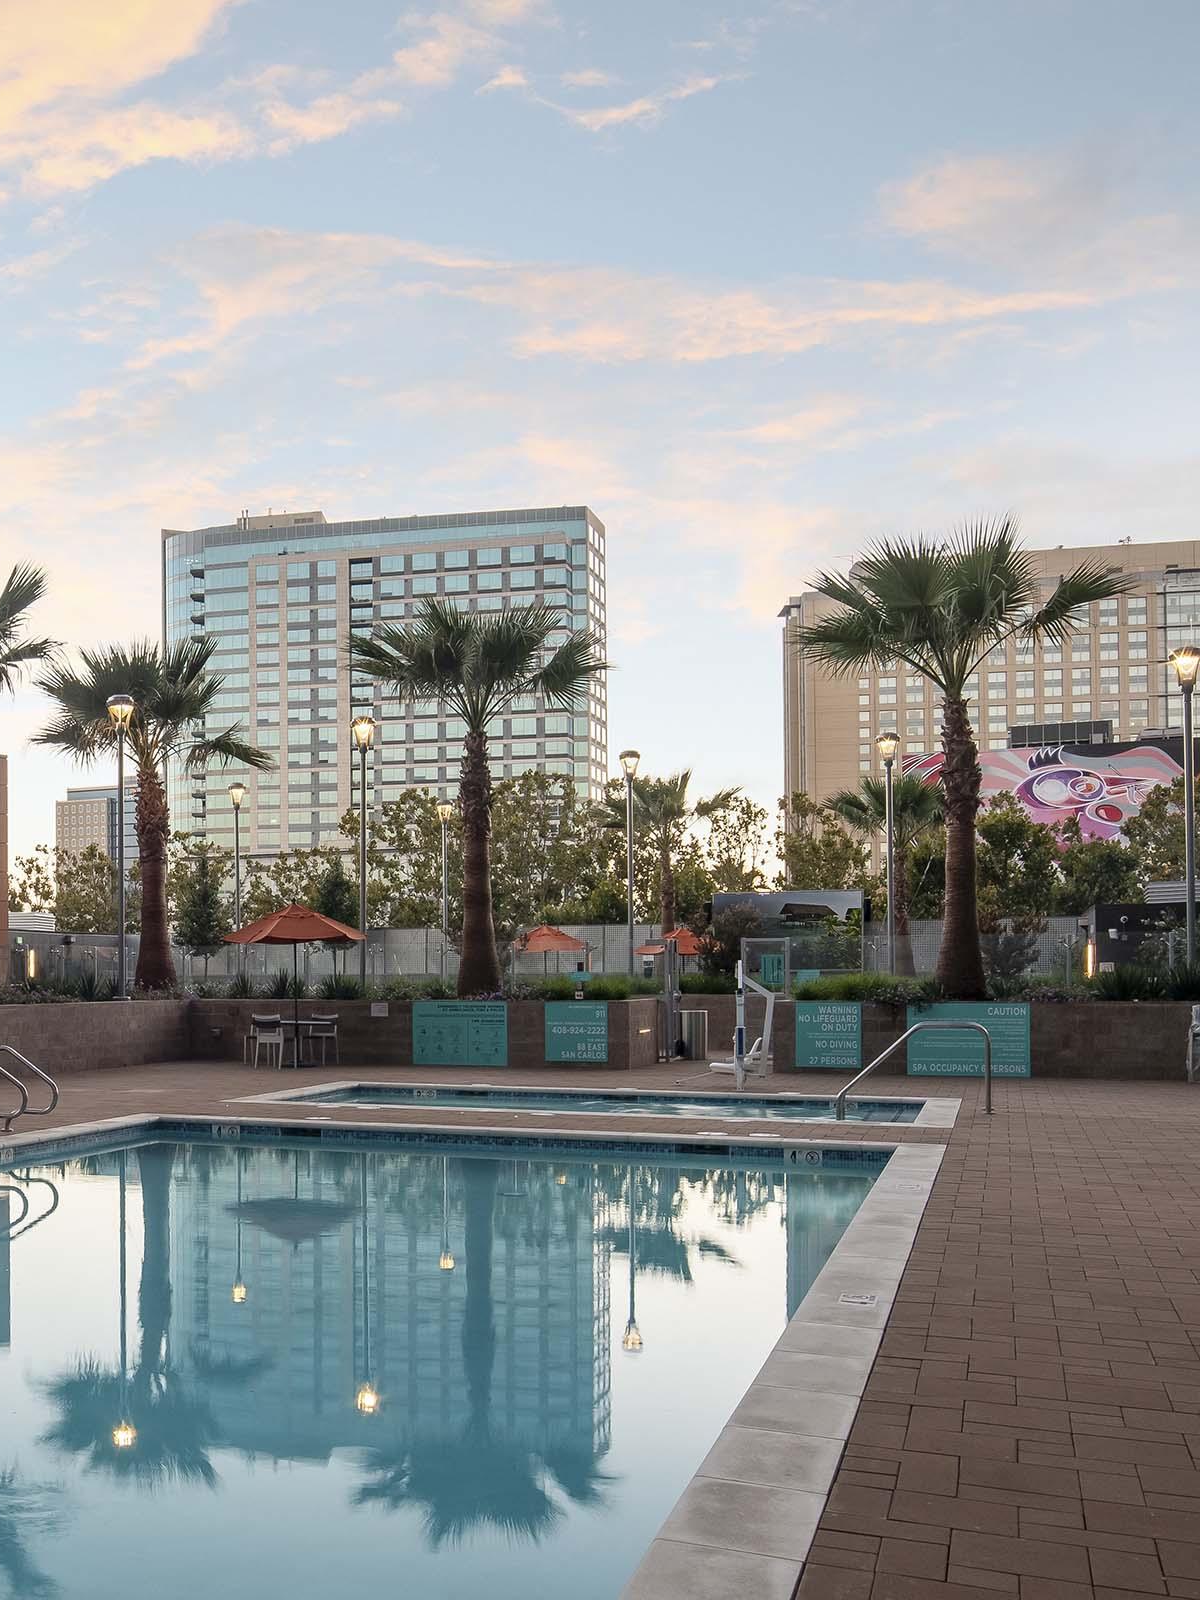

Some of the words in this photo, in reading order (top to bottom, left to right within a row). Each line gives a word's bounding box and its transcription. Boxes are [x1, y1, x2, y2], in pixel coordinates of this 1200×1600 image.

[595, 1010, 606, 1018] 911
[818, 1006, 857, 1014] WARNING
[987, 1007, 1026, 1016] CAUTION
[799, 1014, 810, 1023] NO
[812, 1014, 858, 1023] LIFEGUARD
[821, 1023, 833, 1032] ON
[836, 1023, 858, 1032] DUTY
[587, 1043, 606, 1051] EAST
[815, 1040, 827, 1048] NO
[829, 1040, 858, 1048] DIVING
[561, 1051, 576, 1059] SAN
[577, 1051, 606, 1059] CARLOS
[808, 1056, 818, 1064] 27
[821, 1056, 858, 1065] PERSONS
[912, 1063, 928, 1072] SPA
[930, 1064, 978, 1072] OCCUPANCY
